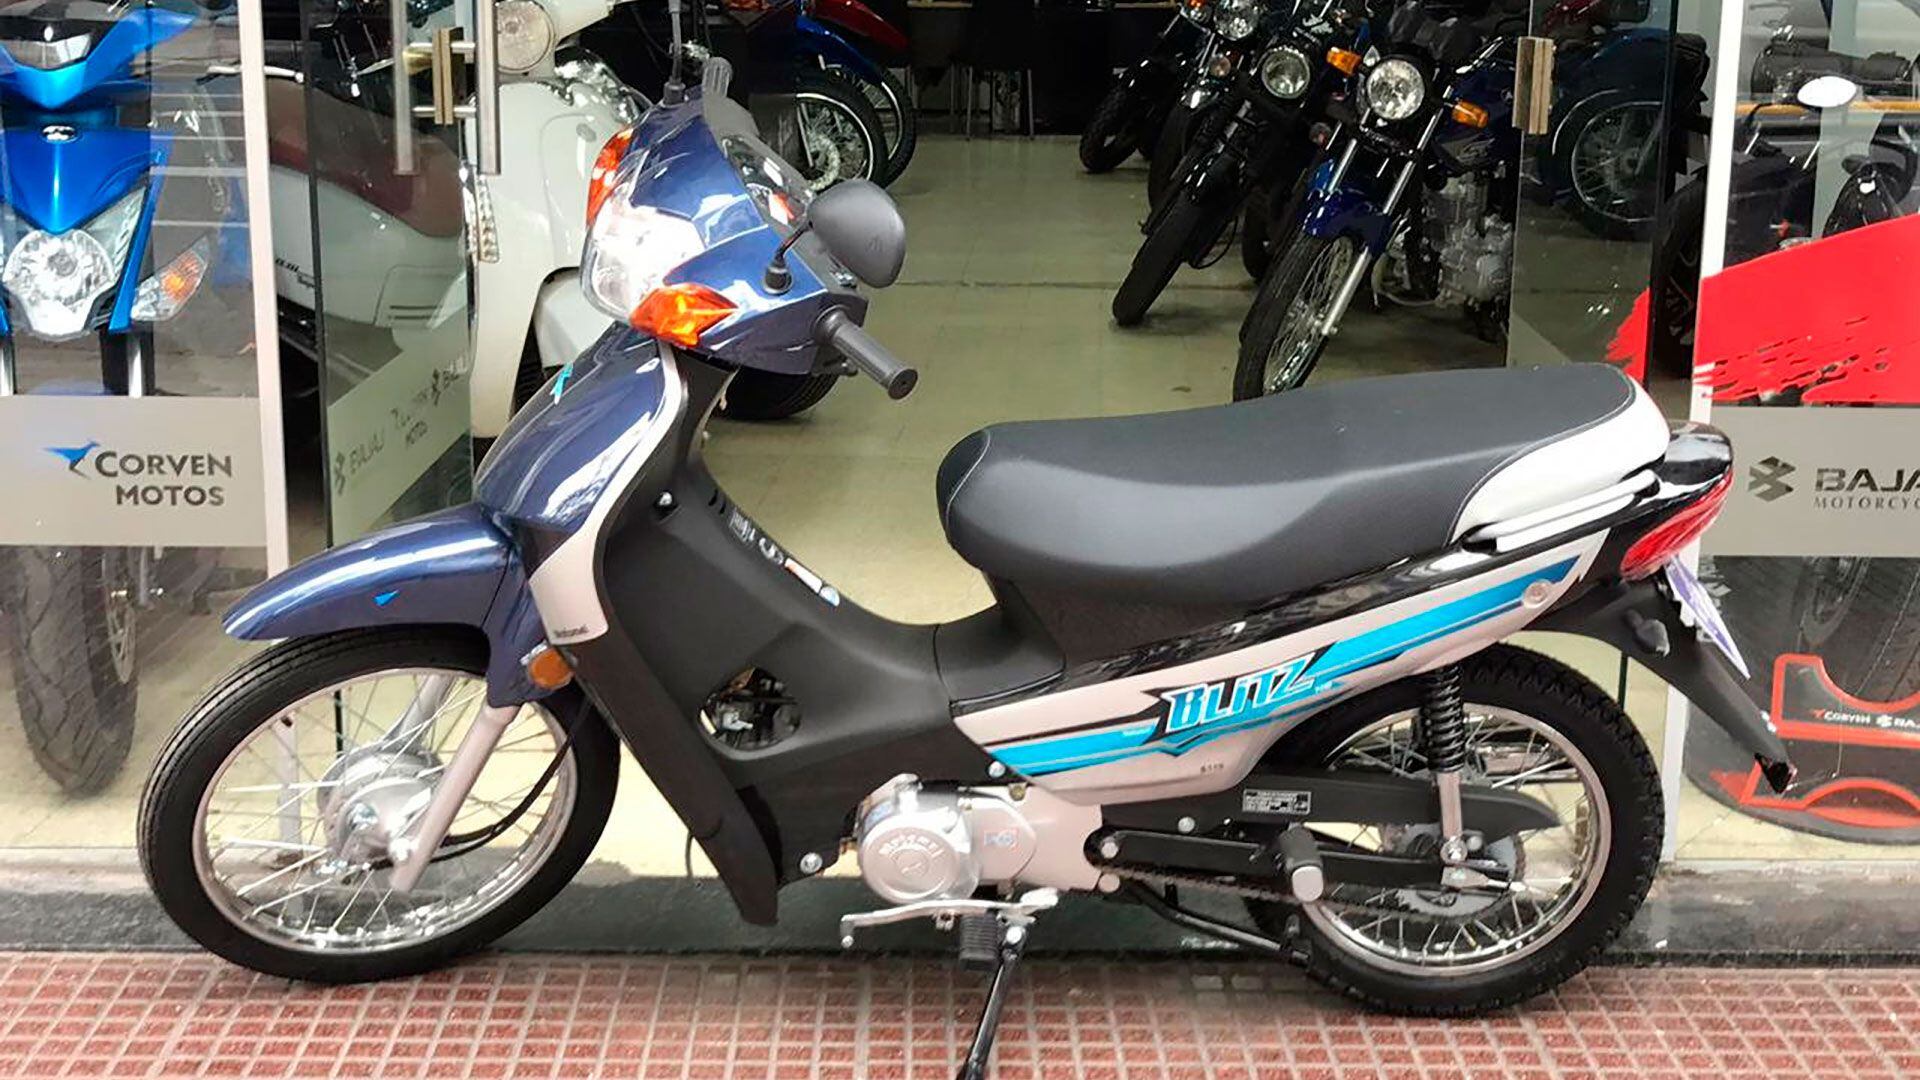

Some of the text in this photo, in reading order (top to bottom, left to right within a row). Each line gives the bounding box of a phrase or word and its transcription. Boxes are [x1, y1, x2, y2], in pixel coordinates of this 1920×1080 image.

[95, 451, 232, 478] CORVEN
[1815, 468, 1920, 492] BAJA
[116, 485, 225, 506] MOTOS
